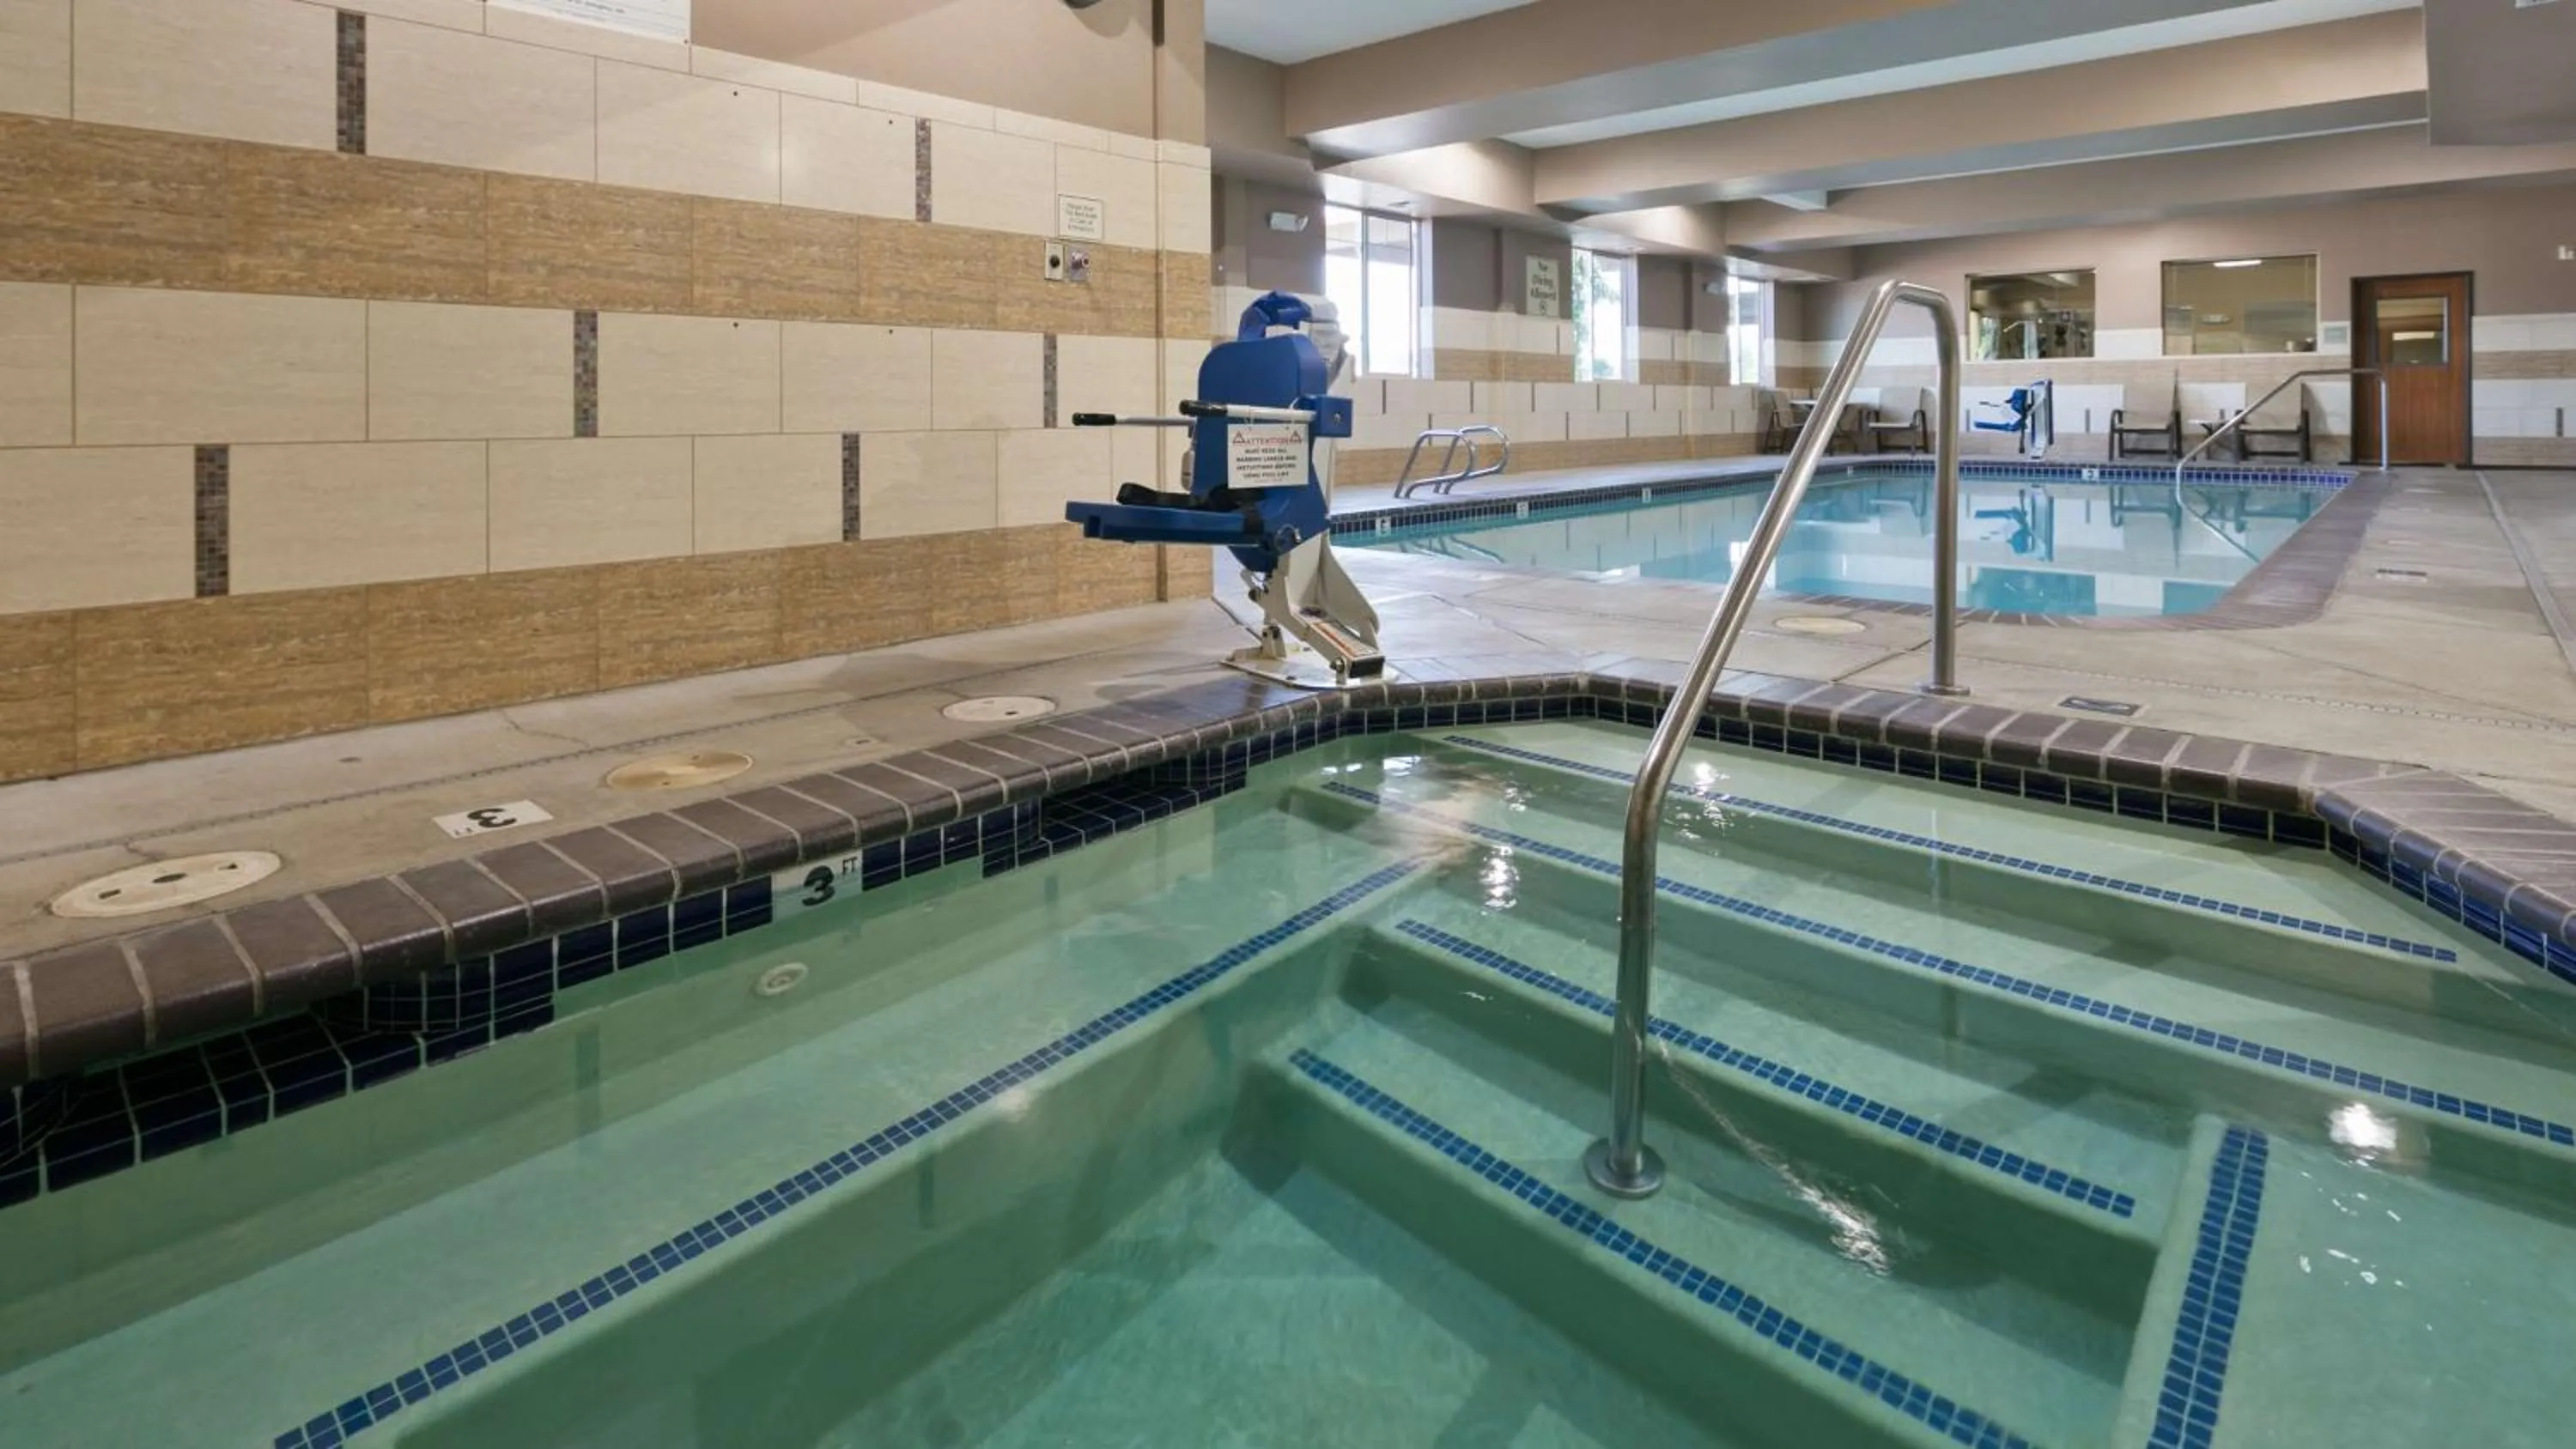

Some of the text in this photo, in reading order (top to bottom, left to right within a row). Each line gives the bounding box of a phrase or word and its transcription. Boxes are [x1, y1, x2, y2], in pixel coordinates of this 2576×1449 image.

[466, 808, 518, 828] 3
[801, 856, 858, 906] 3 FT
